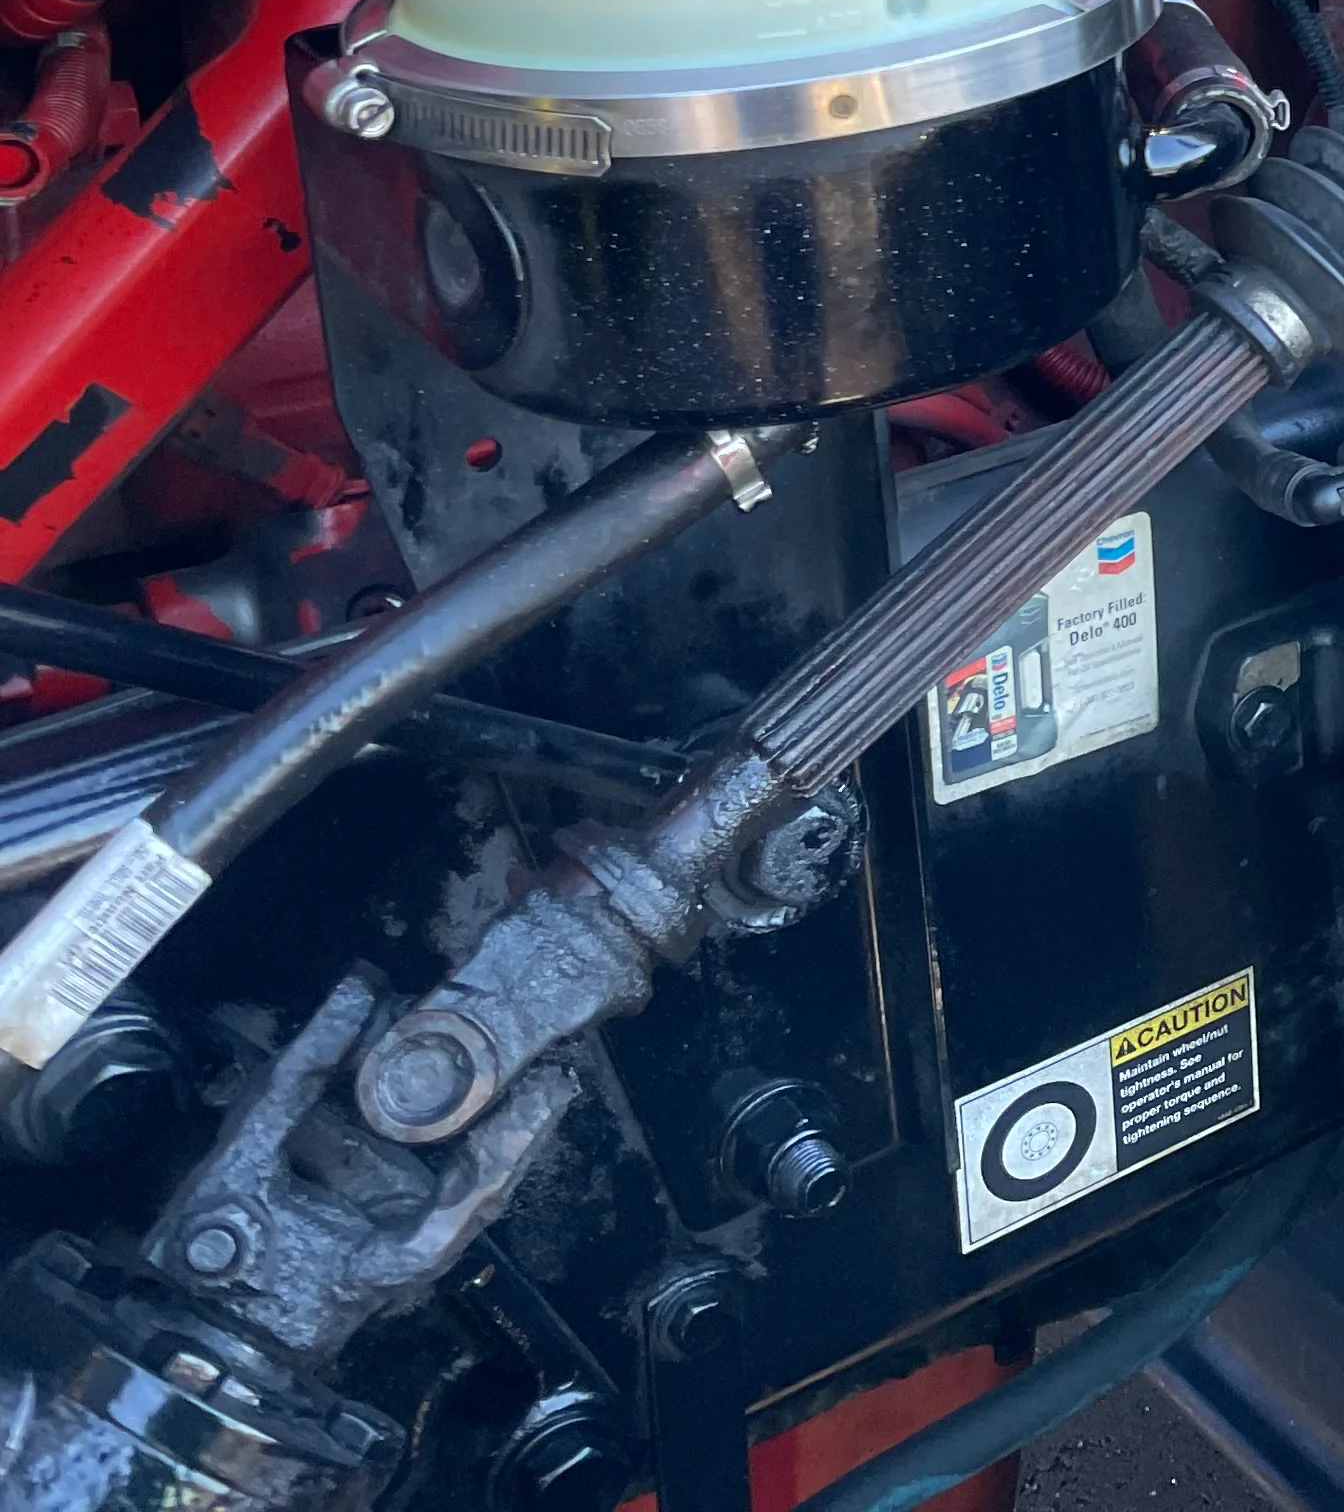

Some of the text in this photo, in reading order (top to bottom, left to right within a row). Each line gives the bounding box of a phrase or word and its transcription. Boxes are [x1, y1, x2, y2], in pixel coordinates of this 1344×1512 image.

[1057, 588, 1146, 636] Factory Filled:
[1113, 610, 1136, 632] 400
[992, 672, 1010, 711] Delo
[1136, 979, 1246, 1051] CAUTION
[1118, 1021, 1228, 1084] Maintain wheel/nut
[1119, 1049, 1203, 1101] tightness. See
[1120, 1046, 1243, 1116] operator's manual for
[1121, 1103, 1161, 1132] proper
[1163, 1082, 1202, 1113] torque
[1203, 1070, 1225, 1091] and
[1122, 1108, 1181, 1148] tightening
[1183, 1080, 1241, 1119] sequence.
